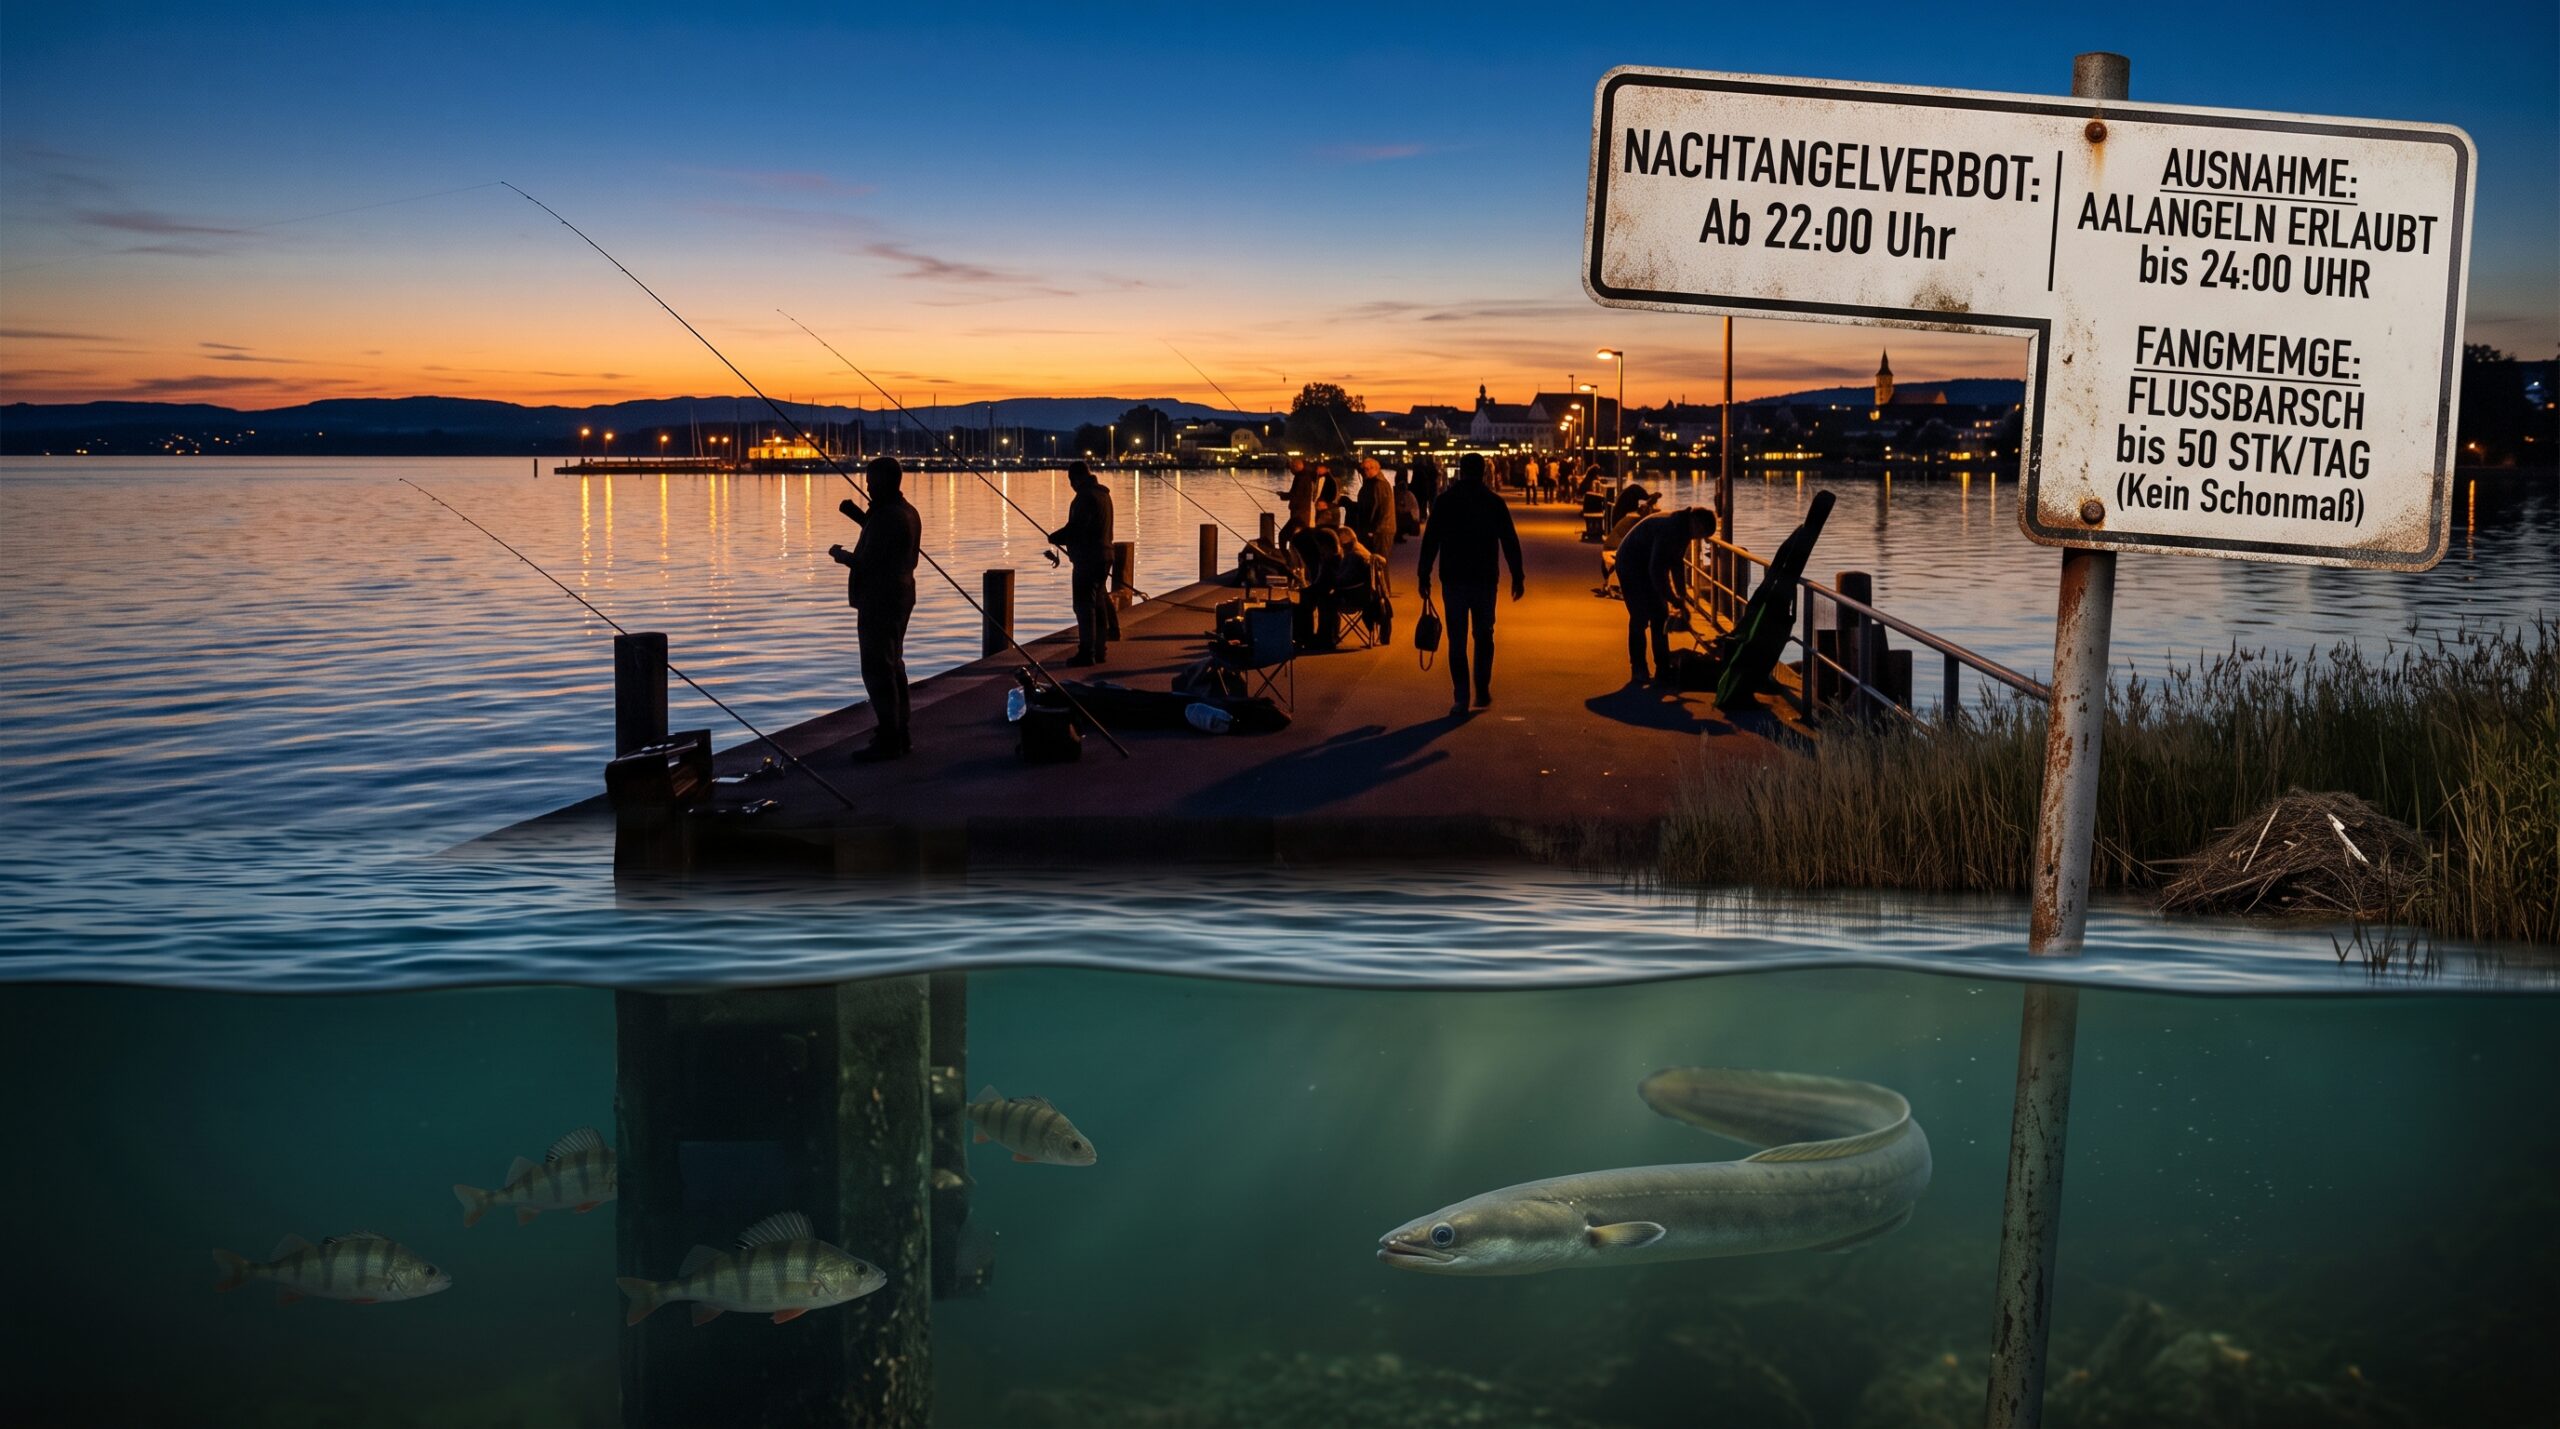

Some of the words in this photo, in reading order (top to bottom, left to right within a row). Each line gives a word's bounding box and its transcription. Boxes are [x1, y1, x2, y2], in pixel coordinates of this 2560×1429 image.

[1623, 127, 2040, 203] NACHTANGELVERBOT:
[2160, 147, 2358, 199] AUSNAHME:
[1698, 197, 1751, 247] Ab
[1764, 201, 1873, 255] 22:00
[1887, 210, 1957, 260] Uhr
[2077, 191, 2277, 244] AALANGELN
[2288, 206, 2438, 255] ERLAUBT
[2139, 243, 2189, 286] bis
[2199, 248, 2292, 293] 24:00
[2303, 255, 2371, 299] UHR
[2135, 325, 2361, 380] FANGMEMGE:
[2127, 375, 2365, 431] FLUSSBARSCH
[2116, 423, 2166, 465] bis
[2177, 427, 2218, 469] 50
[2228, 431, 2371, 480] STK/TAG
[2116, 471, 2190, 512] (Kein
[2200, 478, 2365, 528] Schonmaß)
